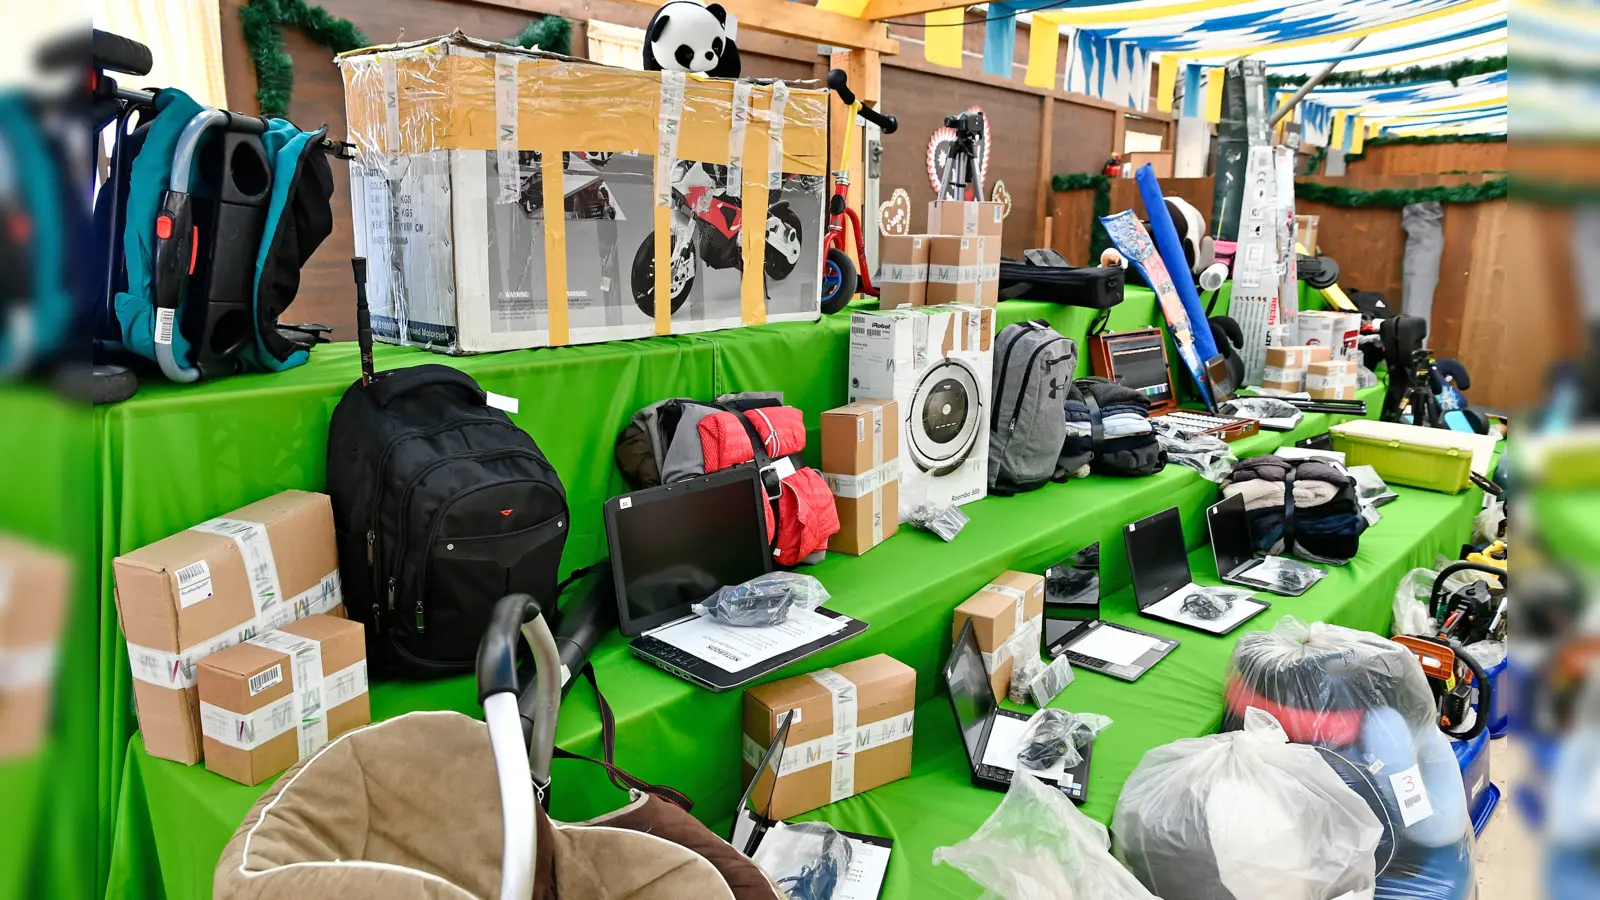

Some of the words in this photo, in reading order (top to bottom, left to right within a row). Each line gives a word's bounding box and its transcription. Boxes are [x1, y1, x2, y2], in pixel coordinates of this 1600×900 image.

[400, 195, 412, 204] KGS
[401, 209, 413, 218] KGS
[966, 222, 976, 234] M
[891, 268, 903, 280] M
[938, 268, 950, 281] M
[871, 322, 891, 330] iRobot
[951, 491, 971, 502] Roomba
[857, 728, 871, 747] M
[806, 742, 822, 764] M
[1401, 775, 1415, 793] 3
